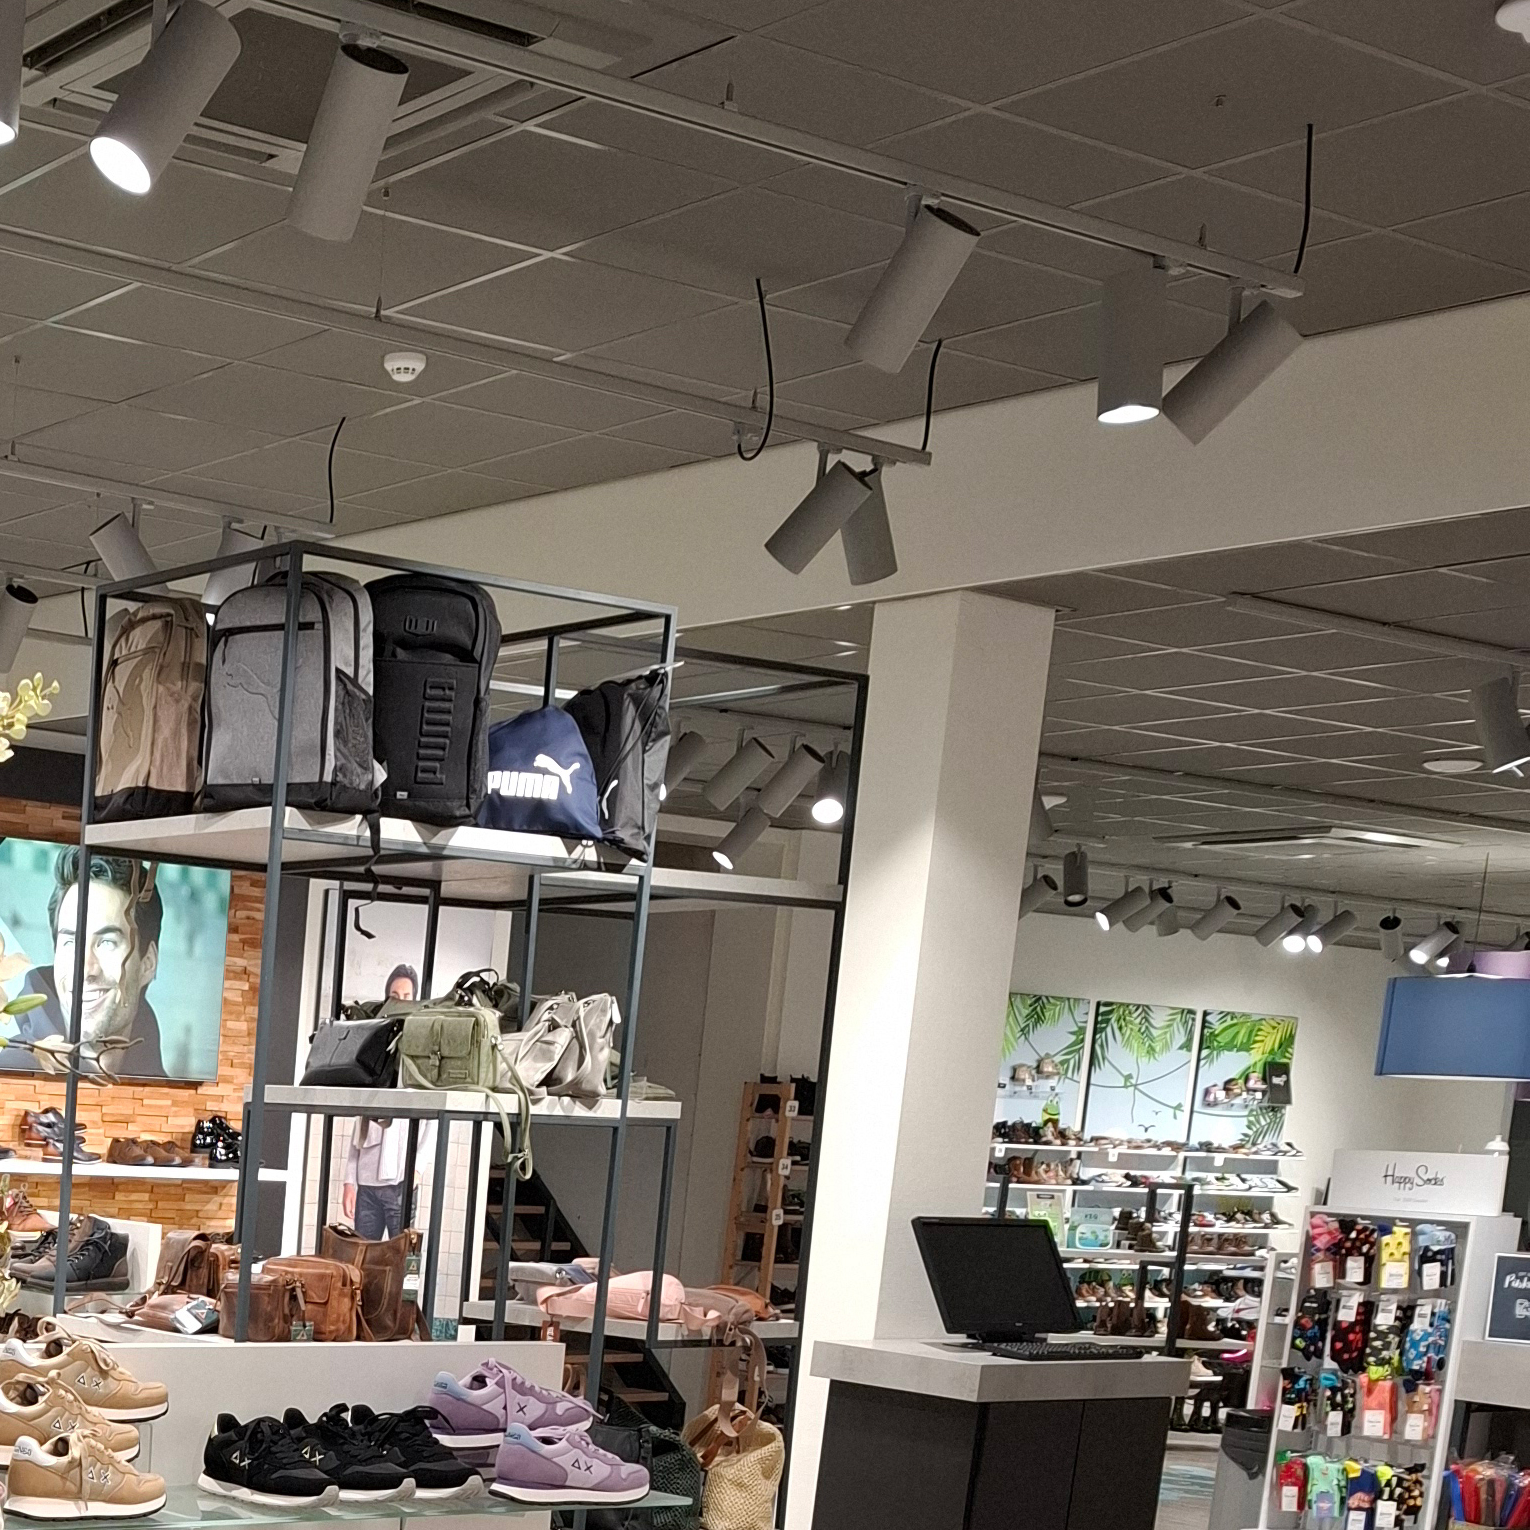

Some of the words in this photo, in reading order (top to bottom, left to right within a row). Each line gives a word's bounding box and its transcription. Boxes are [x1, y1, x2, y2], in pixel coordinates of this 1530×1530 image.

[414, 678, 457, 786] PUMA
[487, 770, 560, 800] PUMA
[1383, 1162, 1415, 1191] Happy
[1415, 1164, 1446, 1187] Socks
